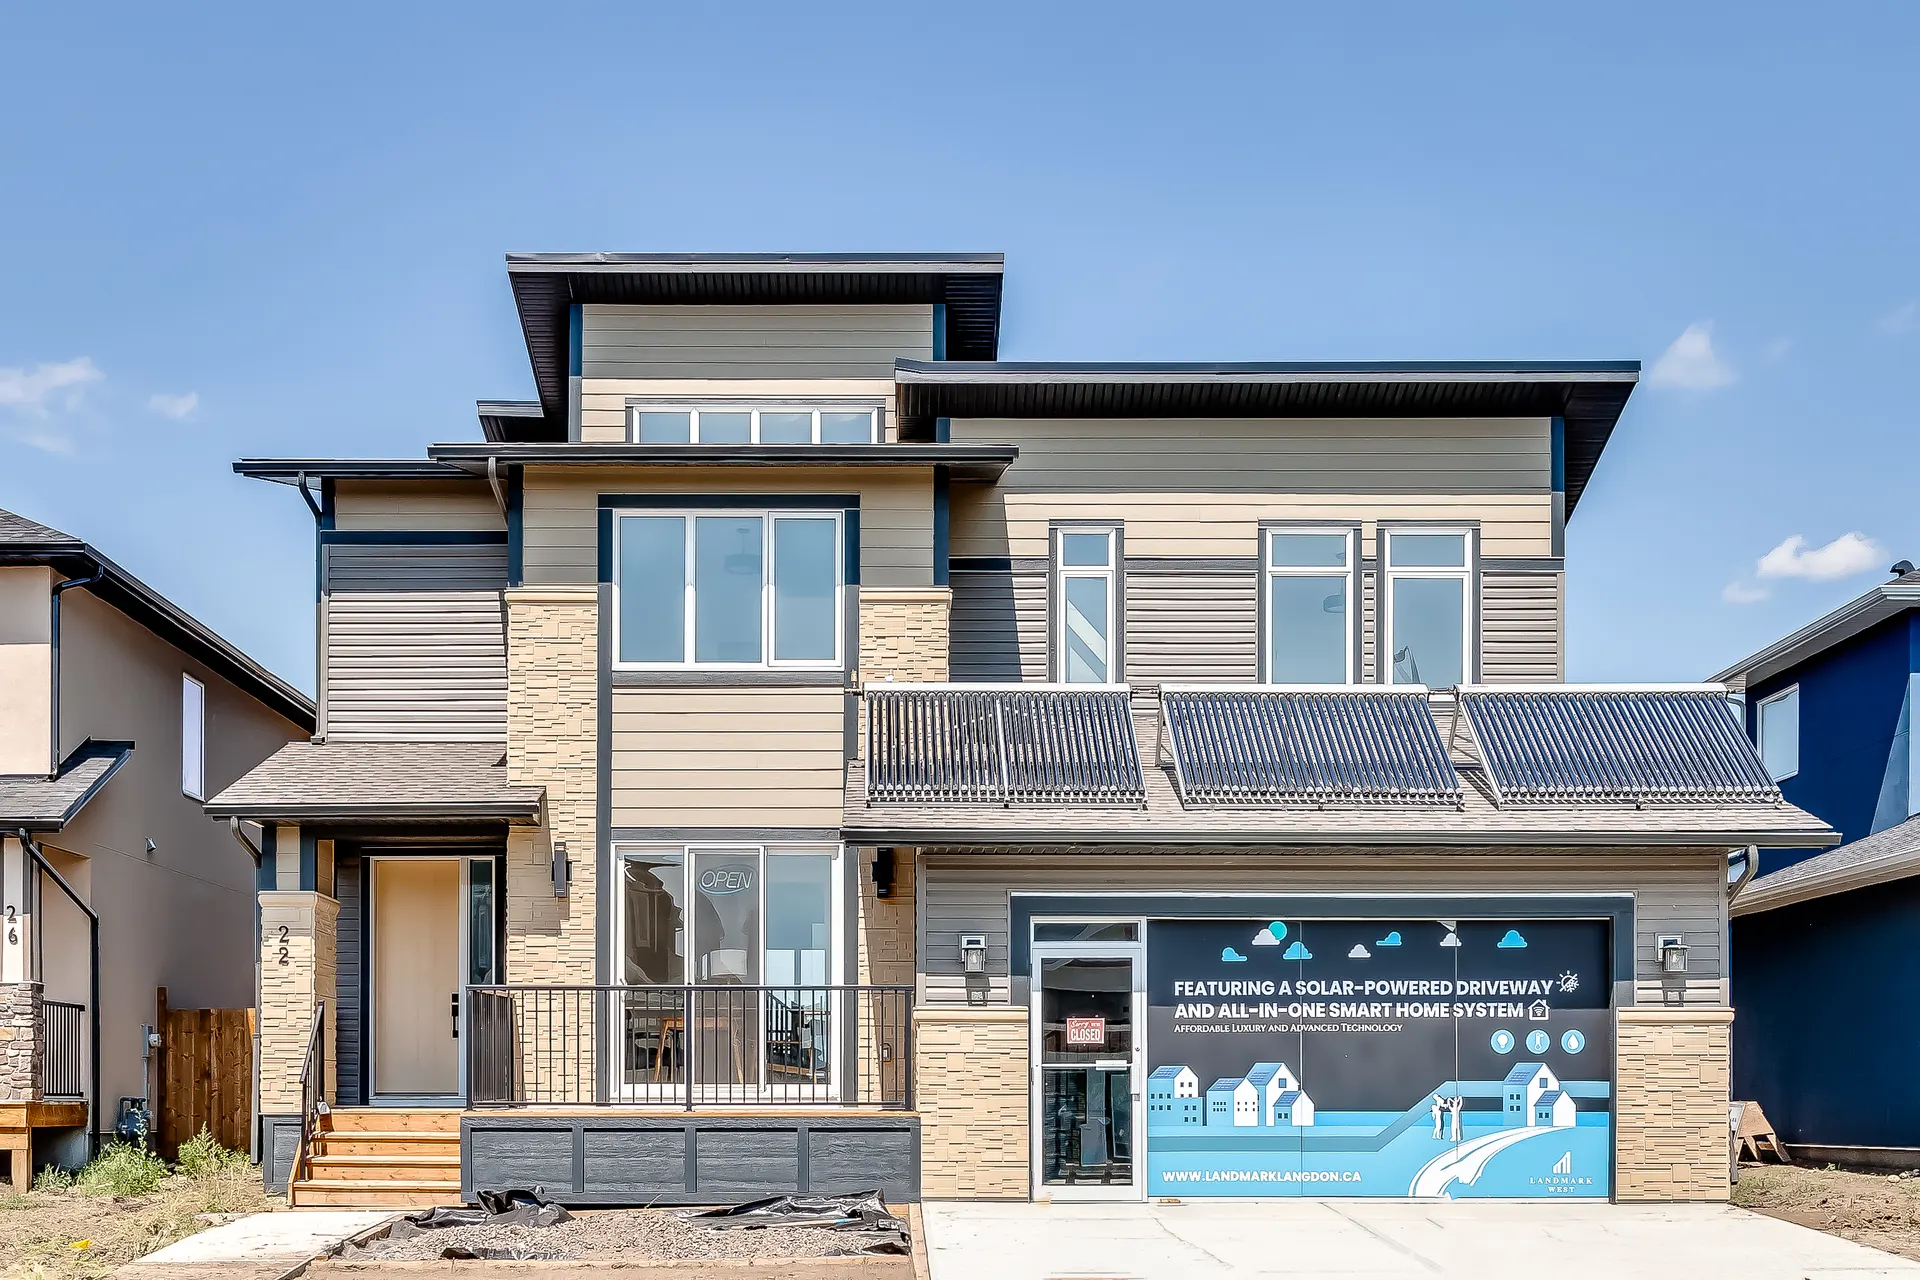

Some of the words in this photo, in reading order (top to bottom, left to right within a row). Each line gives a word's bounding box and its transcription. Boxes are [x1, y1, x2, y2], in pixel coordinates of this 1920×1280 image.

[701, 869, 752, 889] OPEN
[278, 925, 290, 965] 22
[1174, 980, 1275, 997] FEATURING
[1278, 980, 1292, 996] A
[1295, 980, 1453, 996] SOLAR-POWERED
[1456, 980, 1554, 996] DRIVEWAY
[1174, 1003, 1215, 1019] AND
[1217, 1003, 1326, 1018] ALL-IN-ONE
[1329, 1003, 1393, 1018] SMART
[1395, 1002, 1450, 1018] HOME
[1452, 1002, 1524, 1018] SYSTEM
[1070, 1020, 1090, 1029] Sorry
[1071, 1029, 1101, 1041] CLOSED
[1162, 1170, 1362, 1183] WWW.LANDMARKLANGDON.CA
